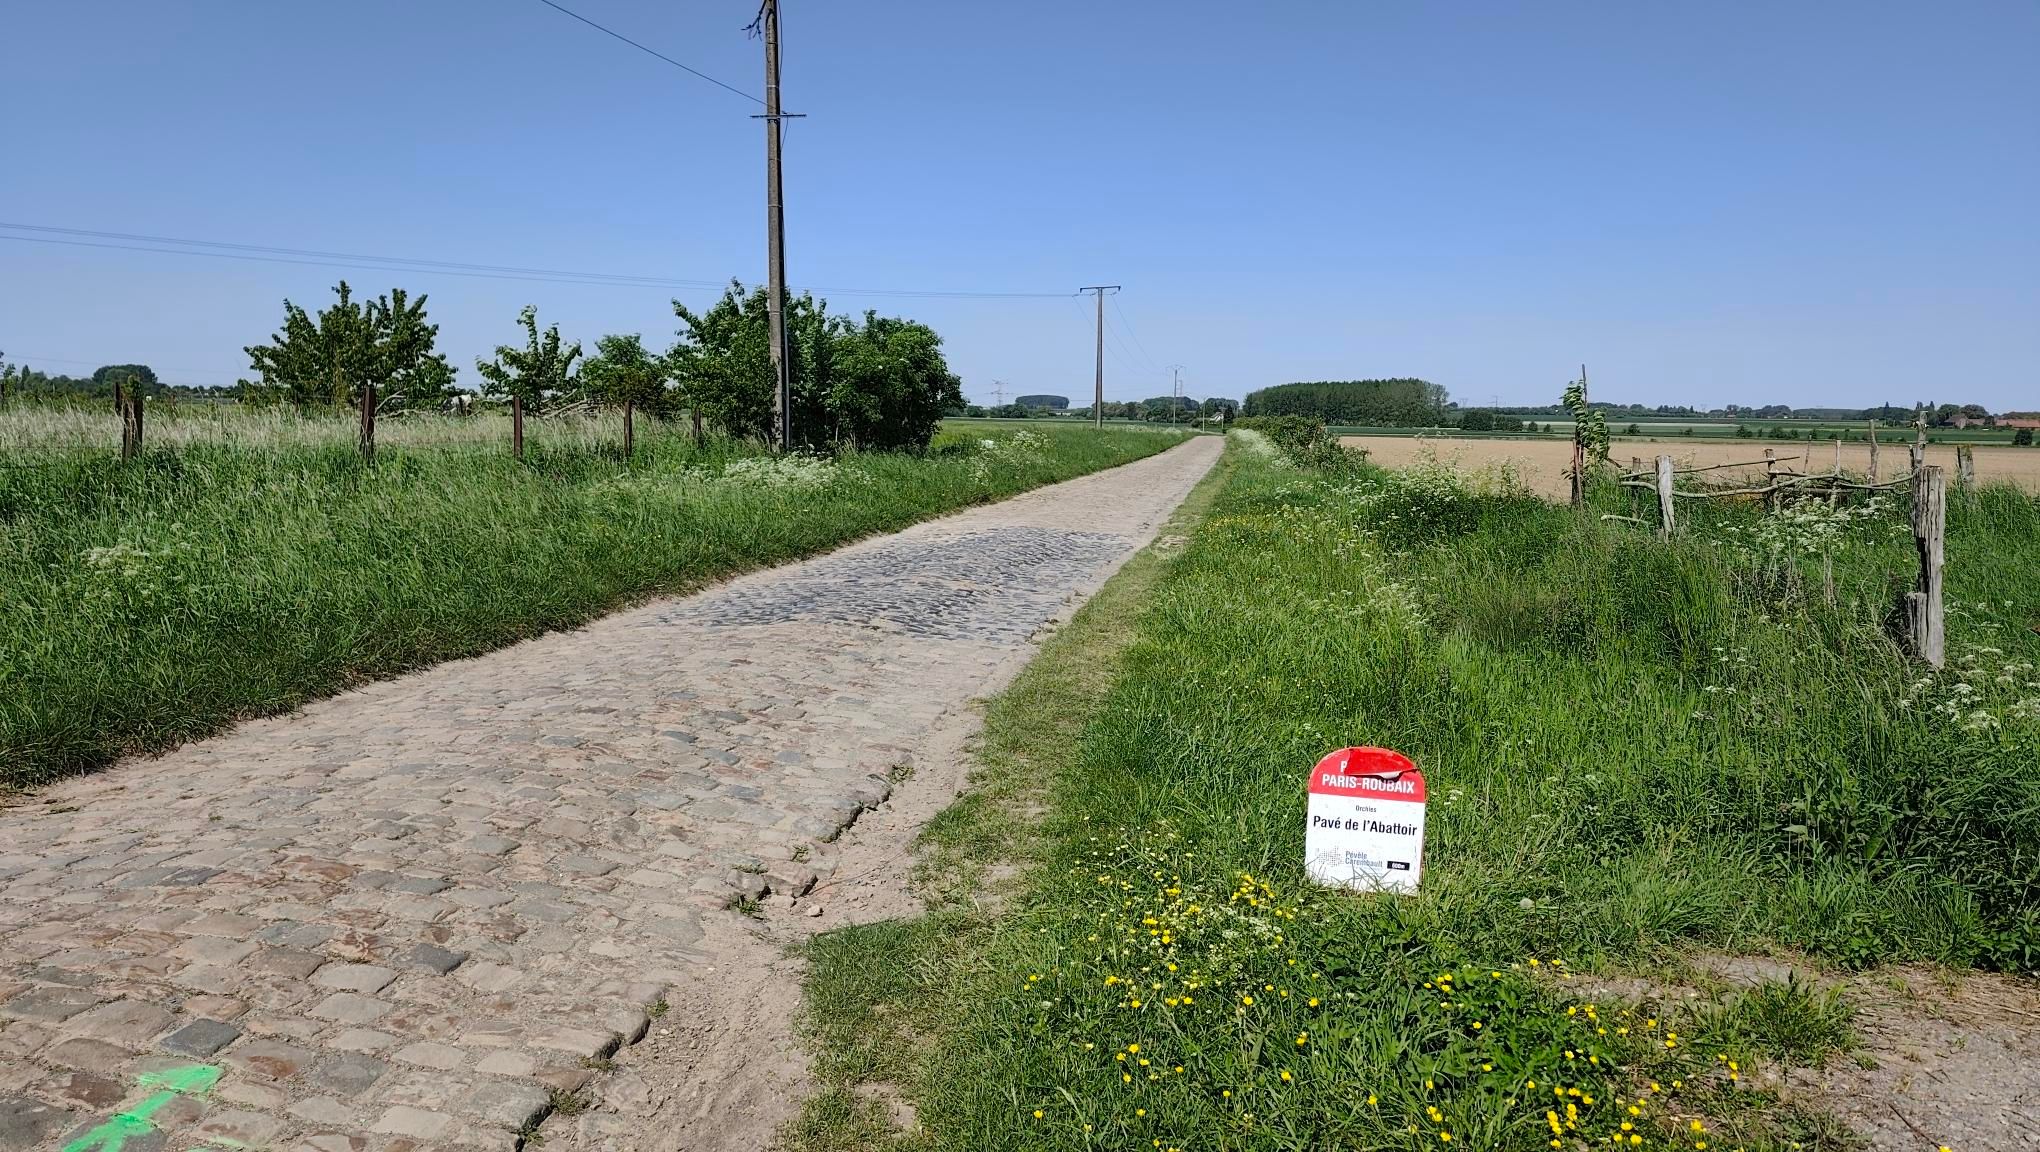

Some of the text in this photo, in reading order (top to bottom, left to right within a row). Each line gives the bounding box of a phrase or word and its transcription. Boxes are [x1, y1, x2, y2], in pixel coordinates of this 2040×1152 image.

[1322, 774, 1415, 794] PARIS-ROUBAIX
[1355, 805, 1377, 813] Orchies
[1313, 815, 1417, 836] Pavé de l'Abattoir
